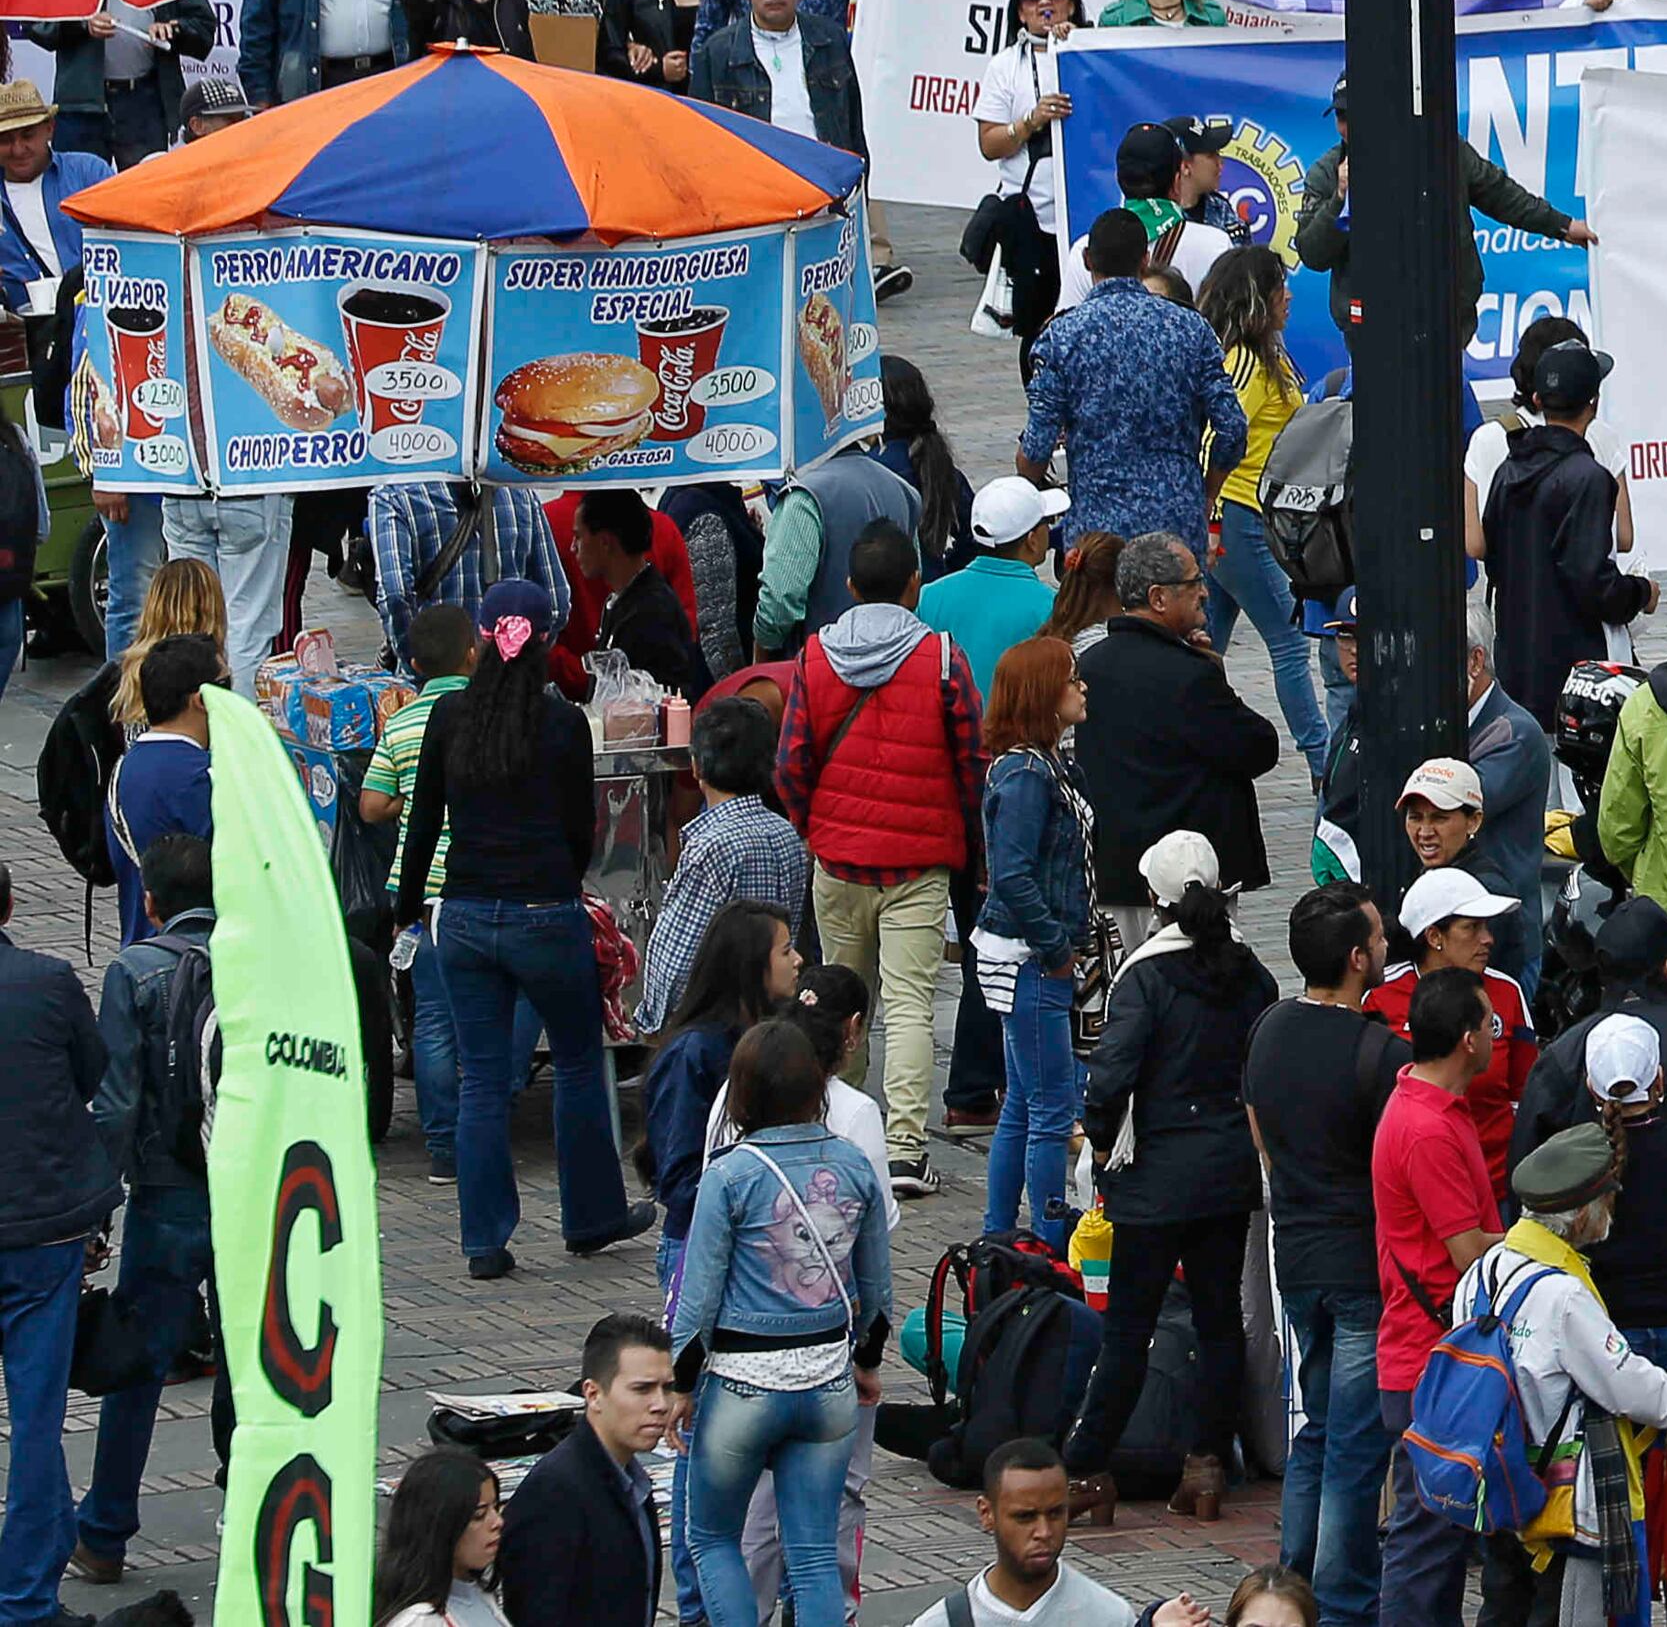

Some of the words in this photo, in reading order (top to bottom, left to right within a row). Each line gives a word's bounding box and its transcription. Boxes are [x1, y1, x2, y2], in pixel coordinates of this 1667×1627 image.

[84, 245, 119, 274] PER
[213, 250, 284, 286] PERRO
[284, 244, 461, 284] AMERICANO
[505, 258, 592, 290] SUPER
[590, 243, 750, 289] HAMBURGUESA
[106, 278, 168, 310] VAPOR
[591, 288, 694, 323] ESPECIAL
[227, 430, 366, 470] CHORIPERRO
[607, 448, 674, 467] GASEOSA
[266, 1029, 348, 1082] COLOMBIA
